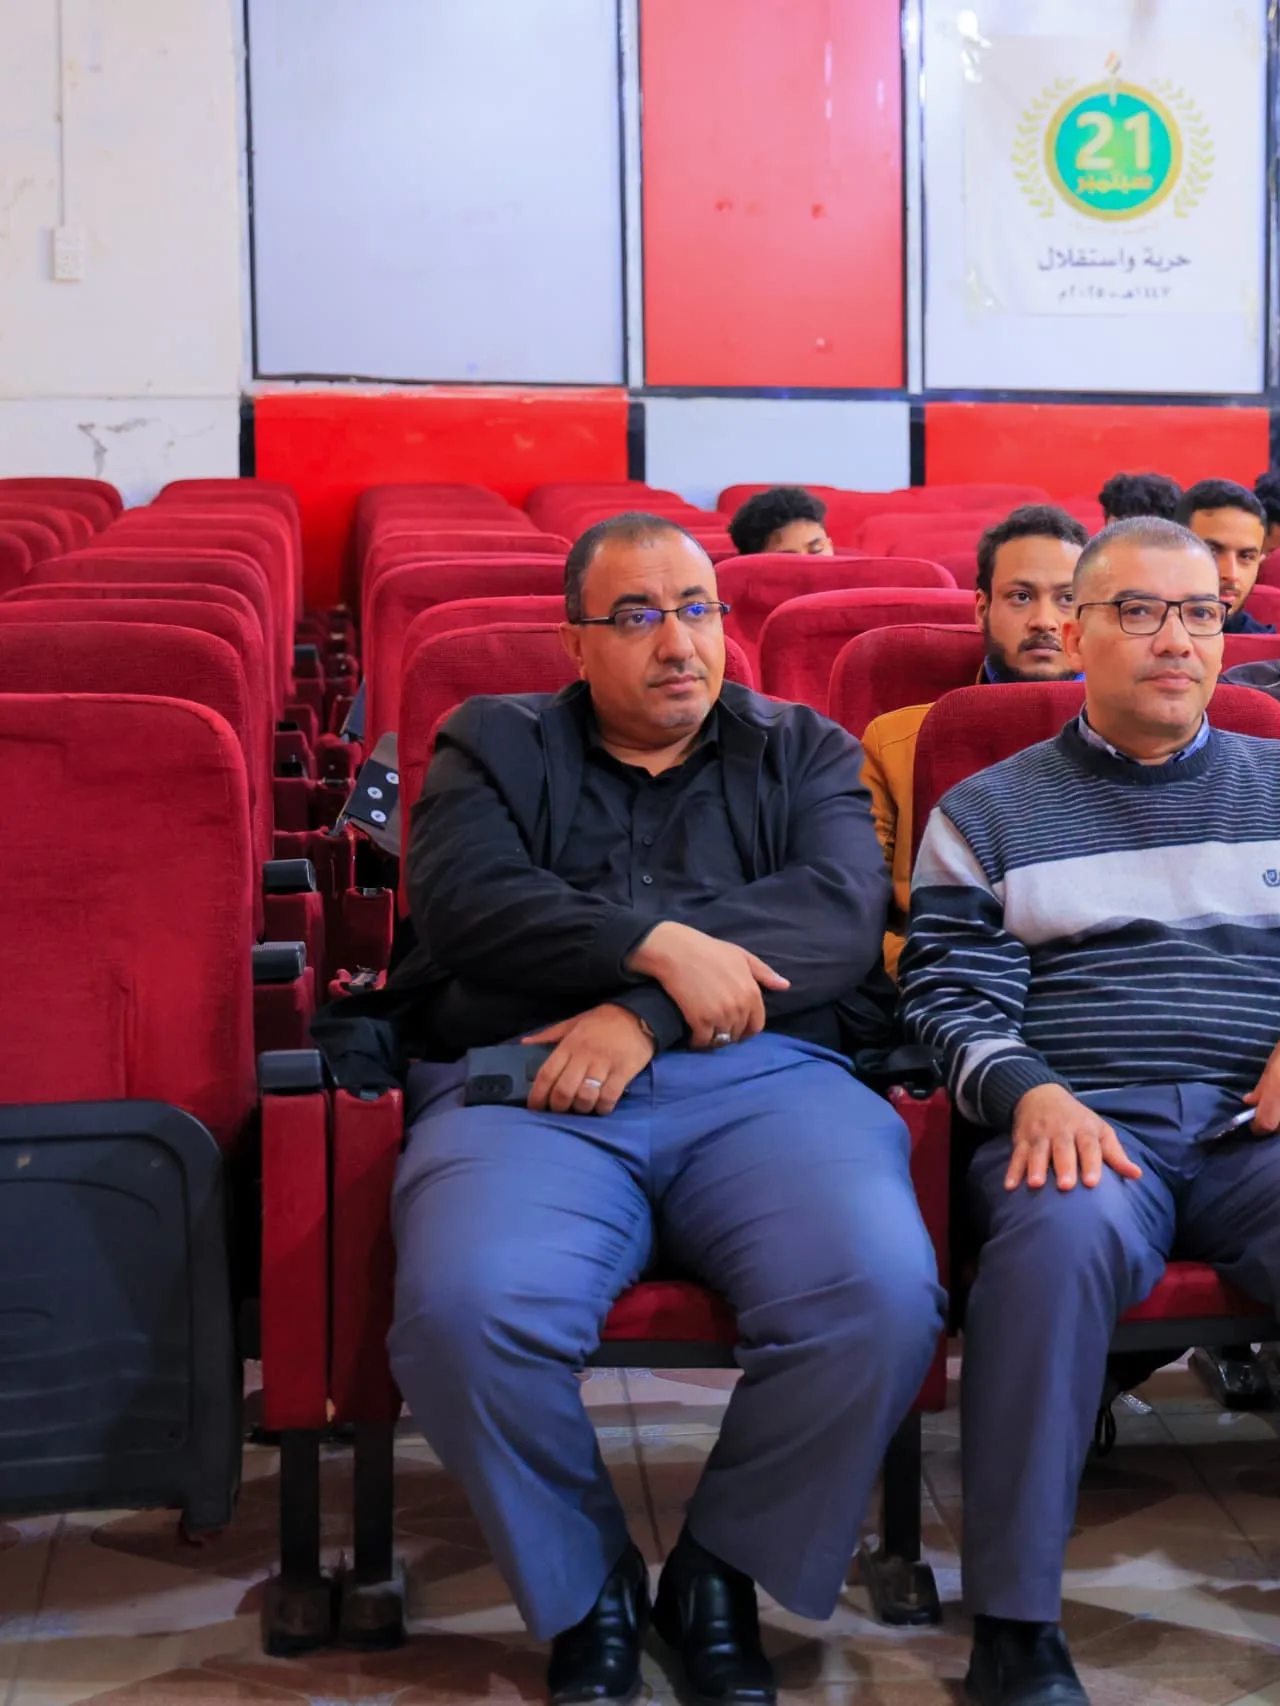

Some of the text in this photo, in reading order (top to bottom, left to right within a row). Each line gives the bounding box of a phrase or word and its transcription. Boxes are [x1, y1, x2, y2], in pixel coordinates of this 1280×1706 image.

[1075, 111, 1150, 170] 21
[1038, 246, 1192, 273] حرية واستقلال
